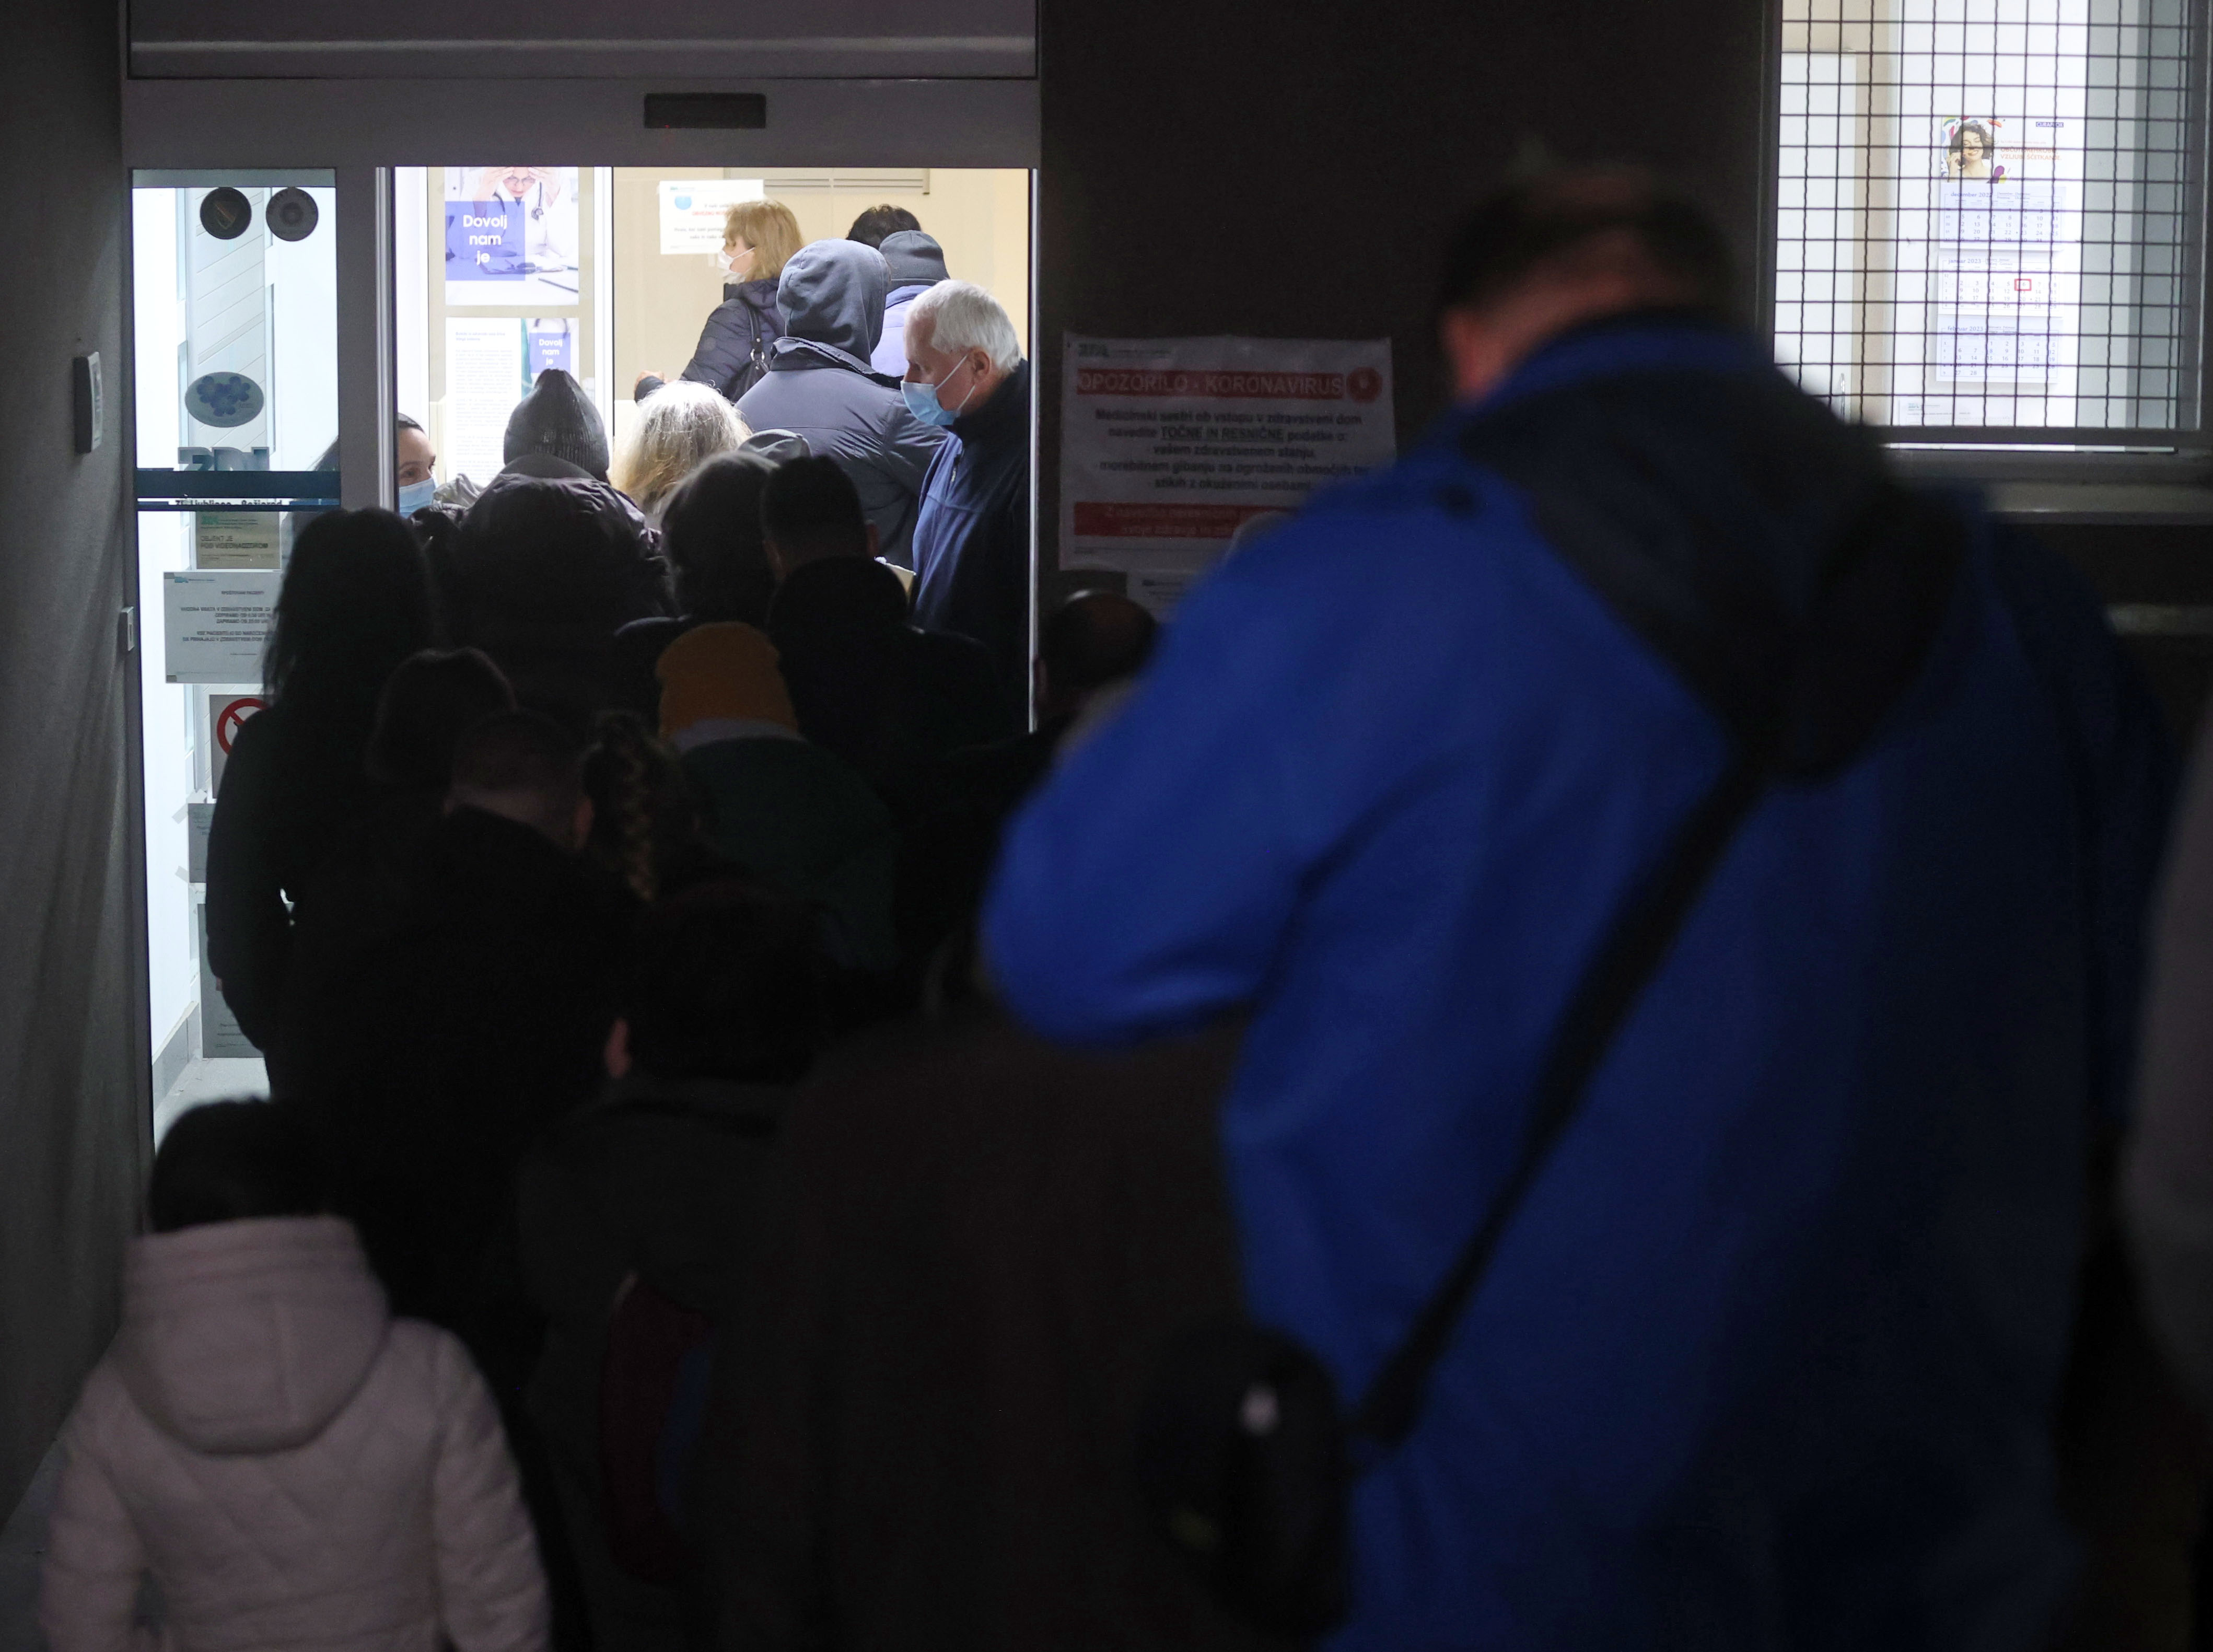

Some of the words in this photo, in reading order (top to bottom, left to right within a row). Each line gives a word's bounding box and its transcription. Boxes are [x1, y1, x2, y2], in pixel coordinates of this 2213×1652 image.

[463, 215, 508, 229] Dovolj
[469, 234, 502, 246] nam
[476, 250, 491, 265] je
[539, 339, 563, 347] Dovolj
[546, 358, 553, 366] je
[1079, 374, 1188, 392] OPOZORILO
[1206, 375, 1342, 395] KORONAVIRUS
[1096, 410, 1157, 420] Medicinski
[1215, 412, 1253, 424] vstopu
[1267, 413, 1333, 424] zdravstveni
[1336, 414, 1361, 424] dom
[1161, 425, 1203, 439] TOČNE
[1207, 427, 1218, 439] IN
[1222, 426, 1284, 440] RESNIČNE
[1195, 445, 1275, 457] zdravstvenem
